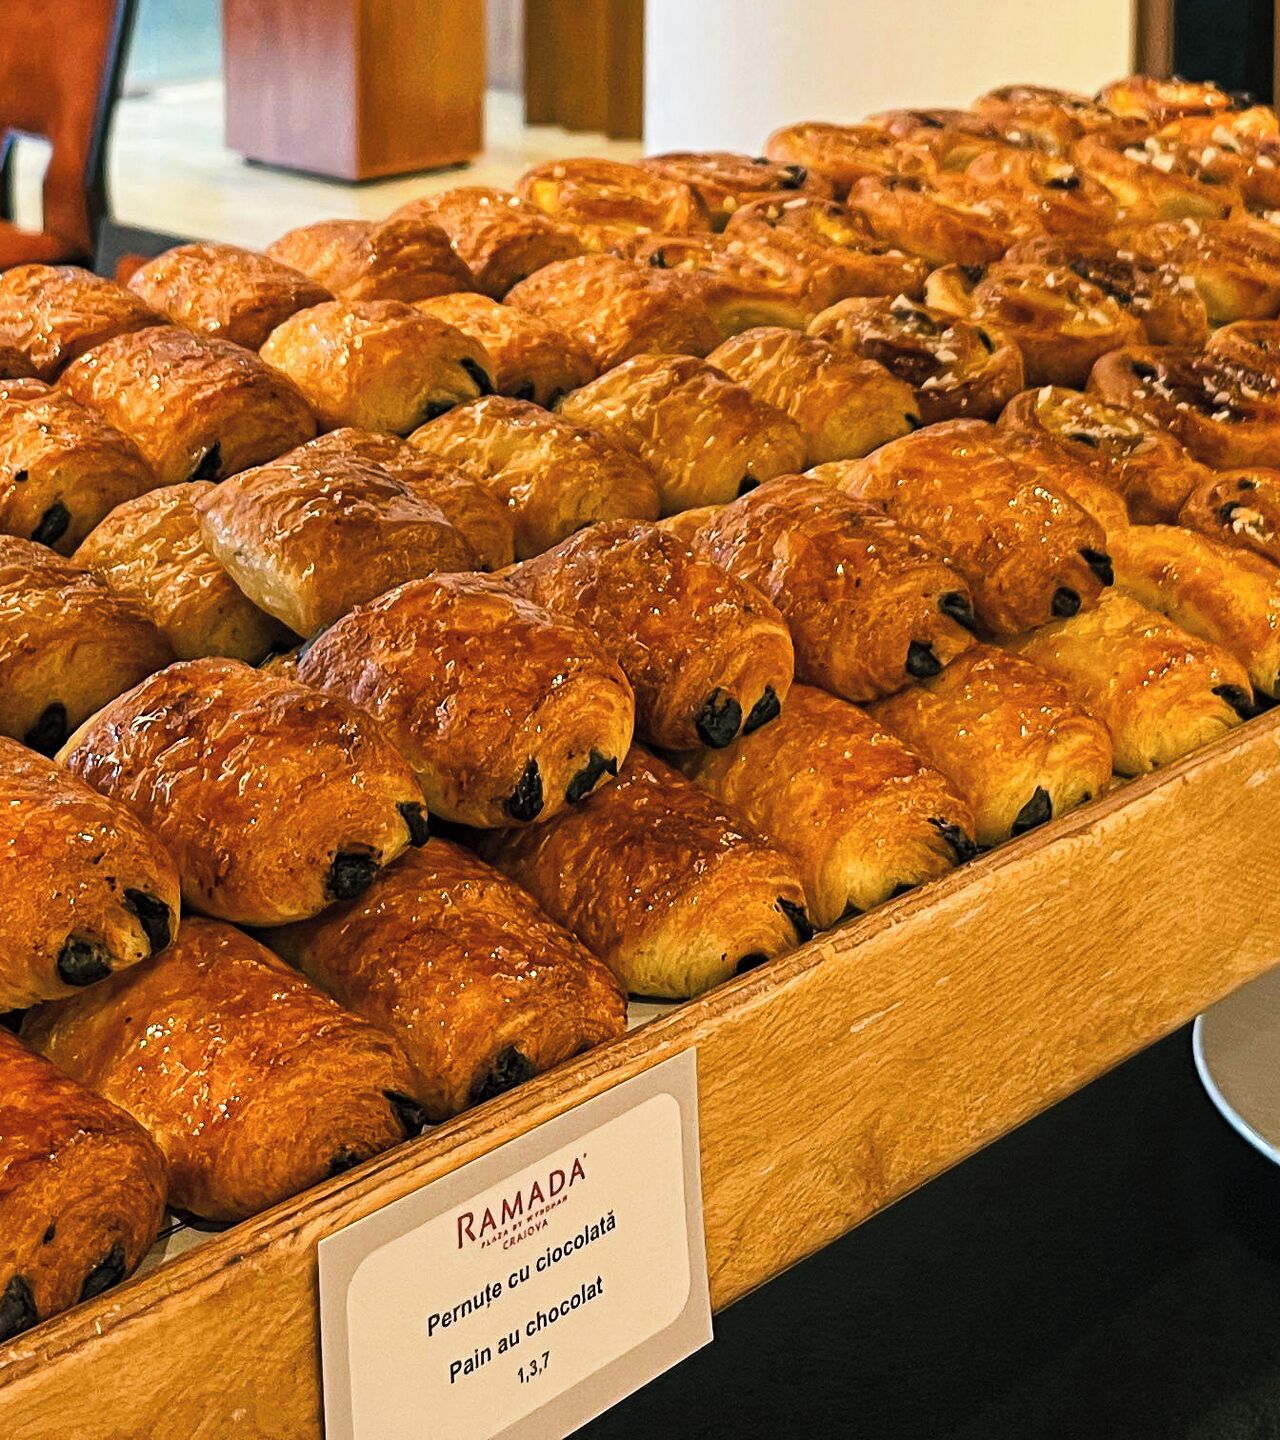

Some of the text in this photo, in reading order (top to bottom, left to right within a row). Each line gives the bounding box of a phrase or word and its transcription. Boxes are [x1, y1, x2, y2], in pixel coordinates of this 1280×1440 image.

[457, 1157, 586, 1249] RAMADA
[503, 1218, 548, 1250] CRAIOVA
[508, 1265, 530, 1290] cu
[535, 1210, 616, 1273] ciocolată
[450, 1275, 604, 1384] Pain au chocolat
[517, 1351, 550, 1385] 1,3,7
